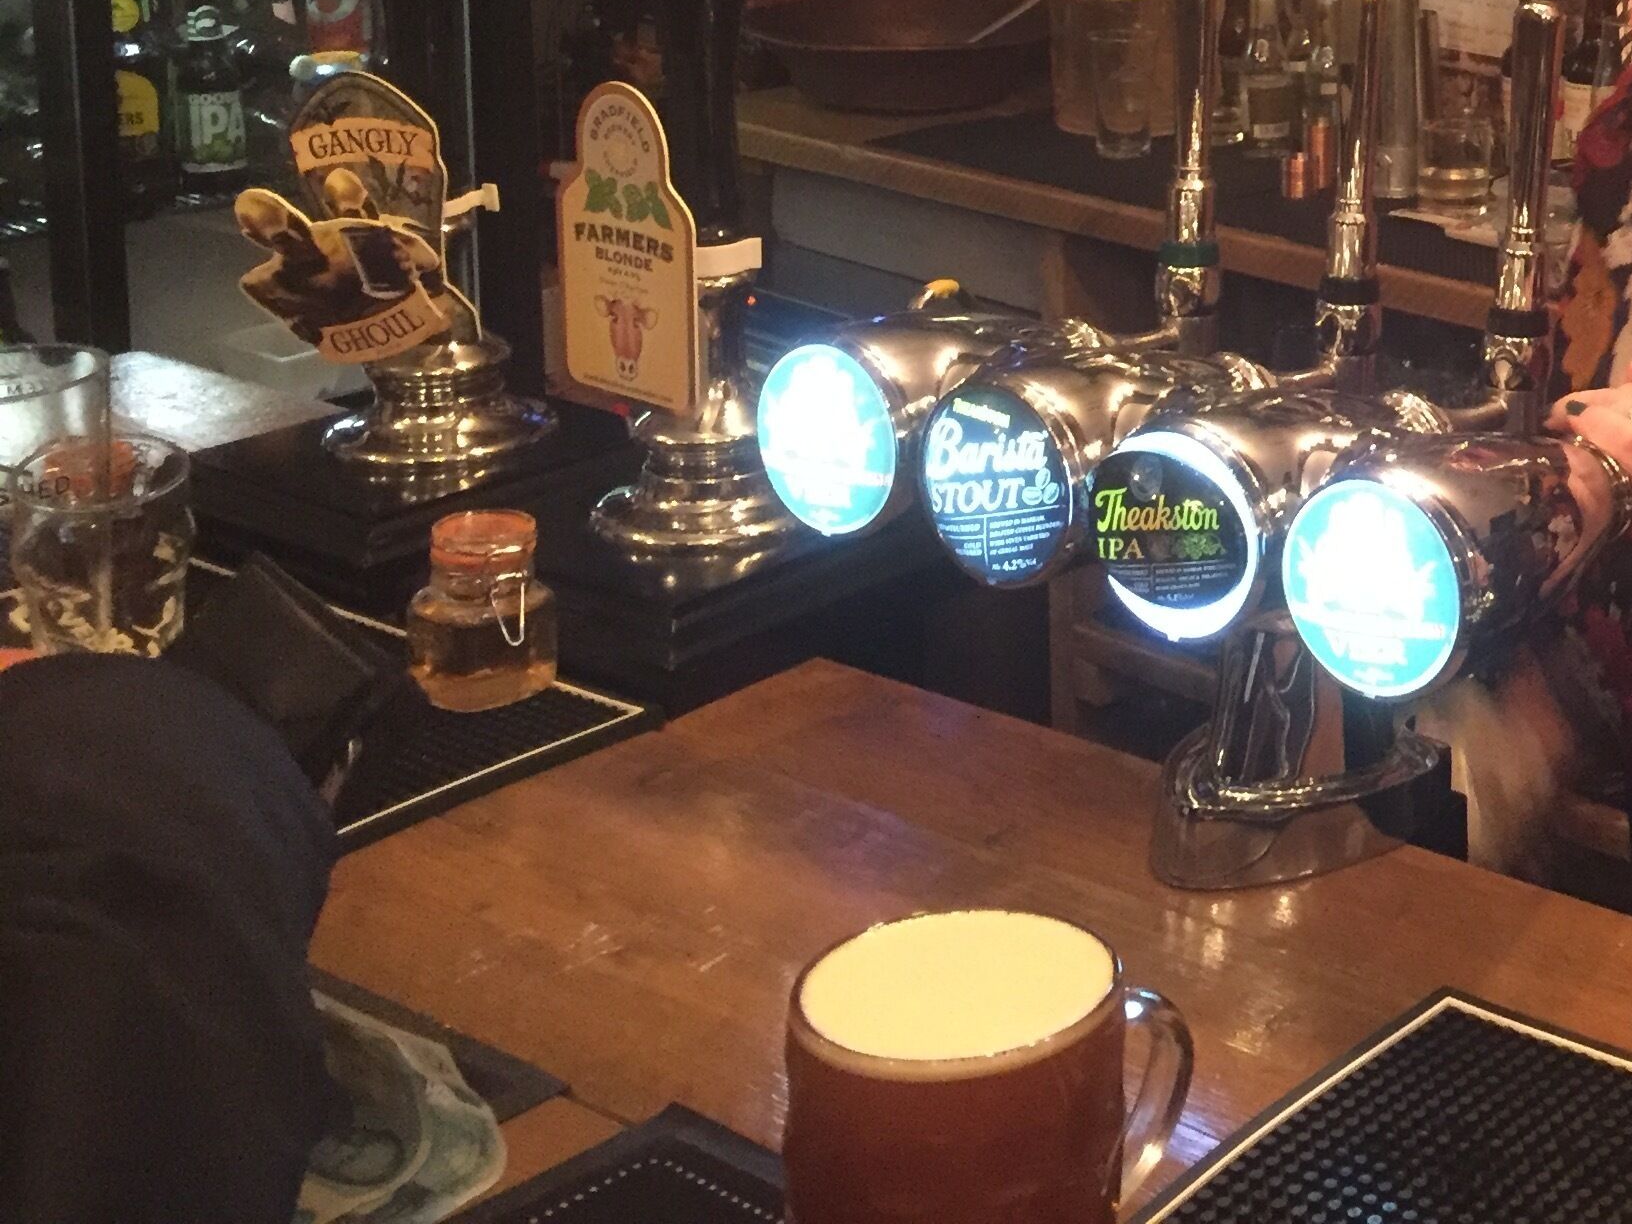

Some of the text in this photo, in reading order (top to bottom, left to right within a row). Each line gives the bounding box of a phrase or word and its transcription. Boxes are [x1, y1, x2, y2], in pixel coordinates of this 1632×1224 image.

[190, 102, 246, 149] IPA
[307, 126, 420, 161] GANGLY
[590, 104, 650, 153] BRADFIELD
[574, 222, 674, 263] FARMERS
[595, 246, 653, 272] BLONDE
[328, 308, 426, 356] GHOUL
[926, 417, 1048, 480] Barista
[932, 477, 1026, 514] STOUT
[1095, 487, 1220, 533] Theakston
[1098, 536, 1145, 560] IPA
